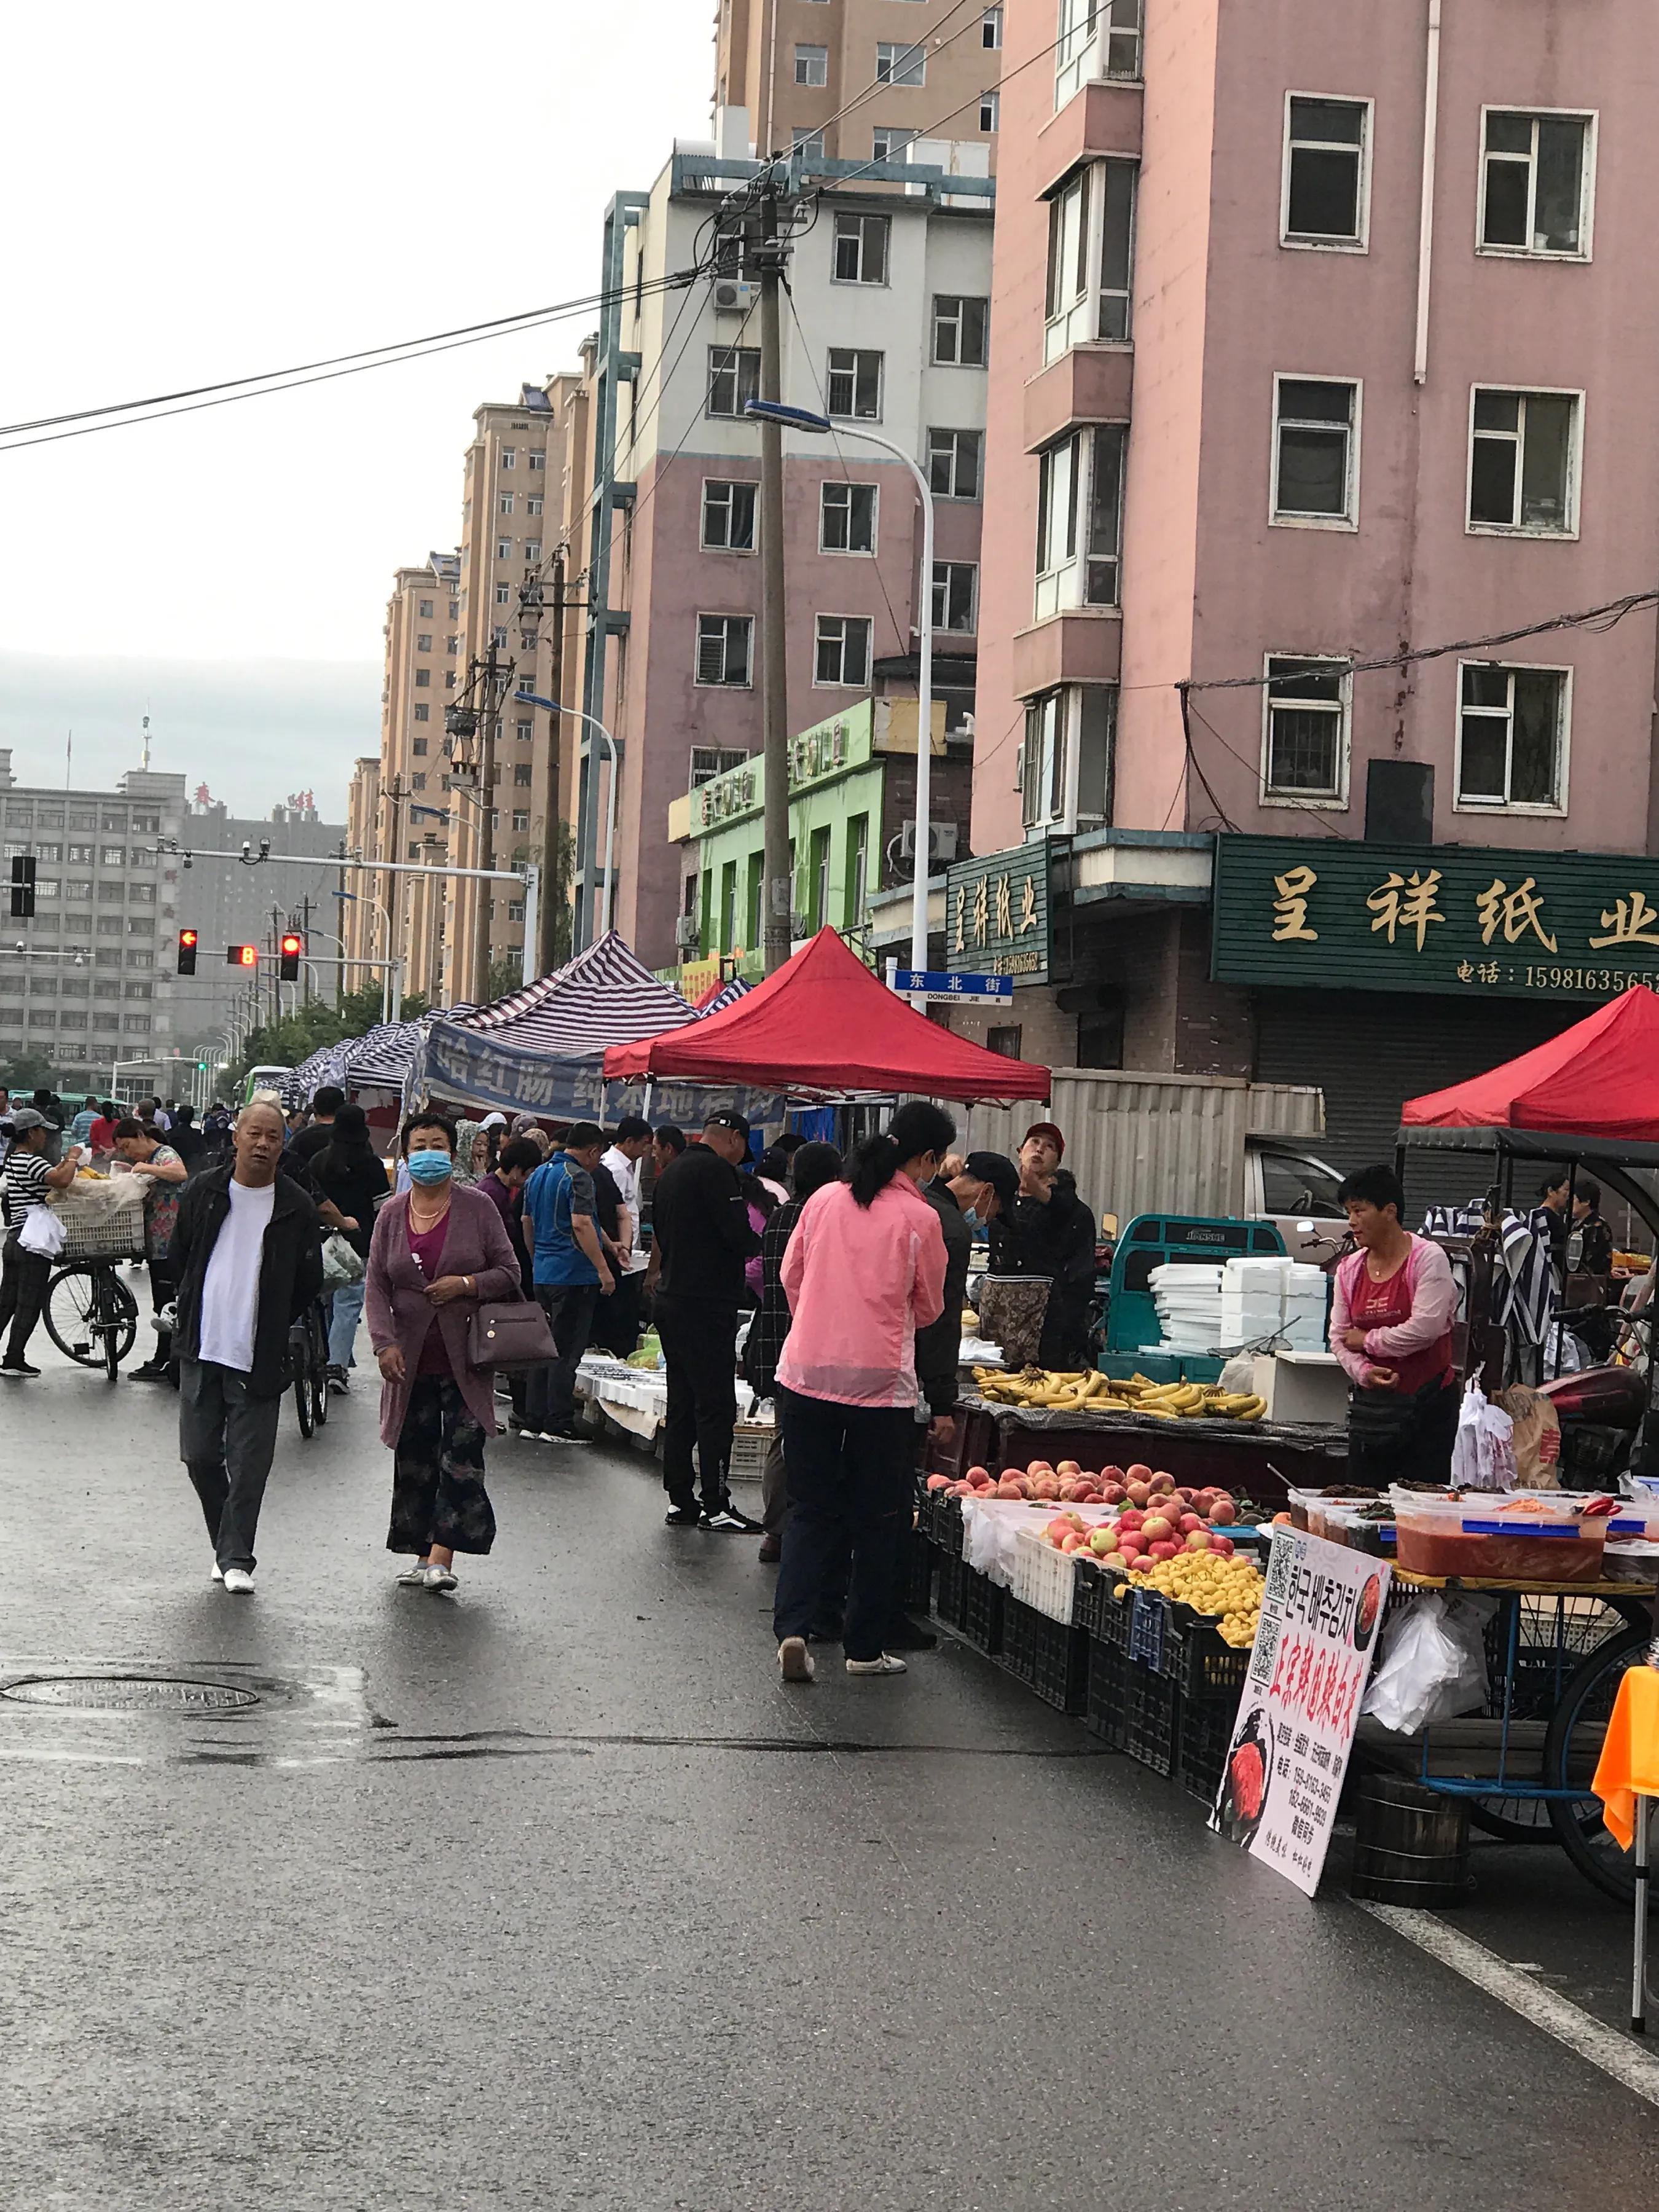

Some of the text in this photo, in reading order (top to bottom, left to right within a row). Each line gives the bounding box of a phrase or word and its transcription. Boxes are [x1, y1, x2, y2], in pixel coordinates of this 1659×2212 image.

[955, 873, 1037, 952] 呈祥纸业
[1271, 866, 1659, 954] 呈祥纸业
[241, 946, 255, 965] 8
[910, 973, 1000, 992] 东北街
[1456, 959, 1659, 994] 电话：1598163565
[1285, 1565, 1358, 1645] 한국 배추김치
[1269, 1633, 1364, 1748] 正宗韩国辣白菜
